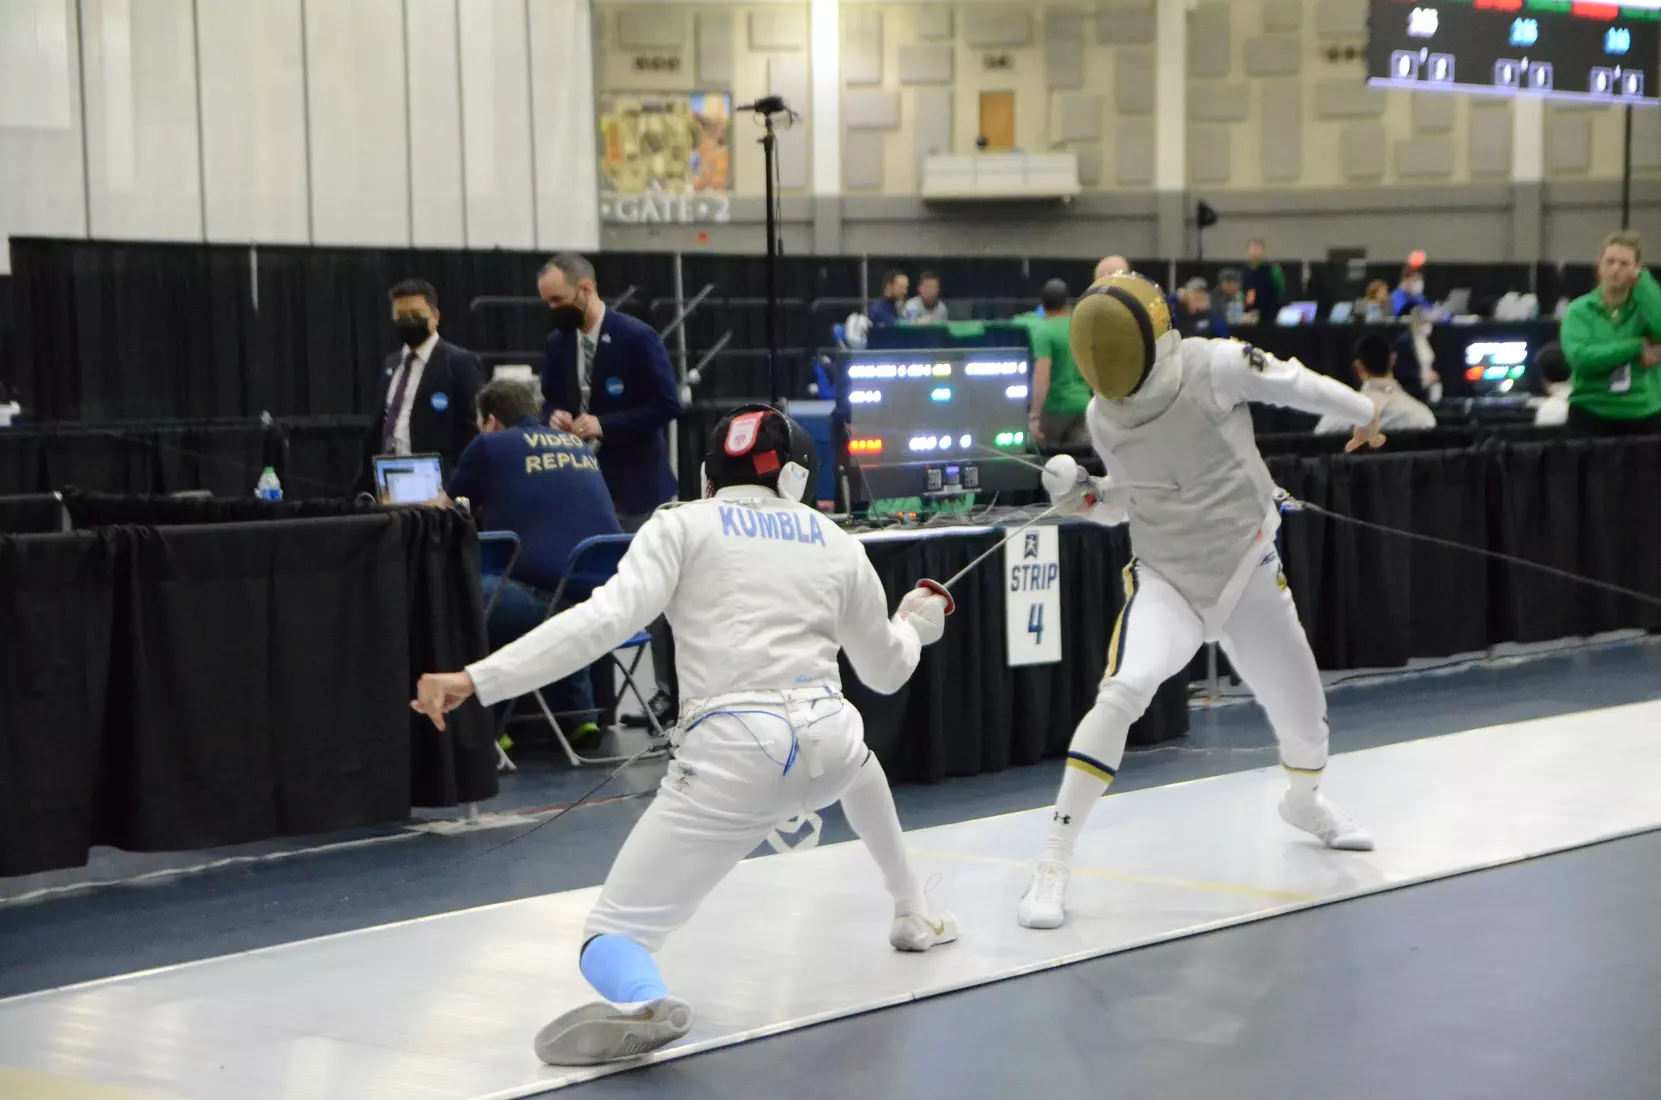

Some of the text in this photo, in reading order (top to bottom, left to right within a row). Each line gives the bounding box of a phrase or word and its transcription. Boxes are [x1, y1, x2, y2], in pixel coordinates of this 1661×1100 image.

[615, 198, 730, 222] GATE 2
[523, 432, 584, 448] VIDEO
[525, 451, 599, 474] REPLAY
[719, 506, 825, 546] KUMBLA
[1010, 563, 1058, 591] STRIP
[1027, 603, 1044, 645] 4
